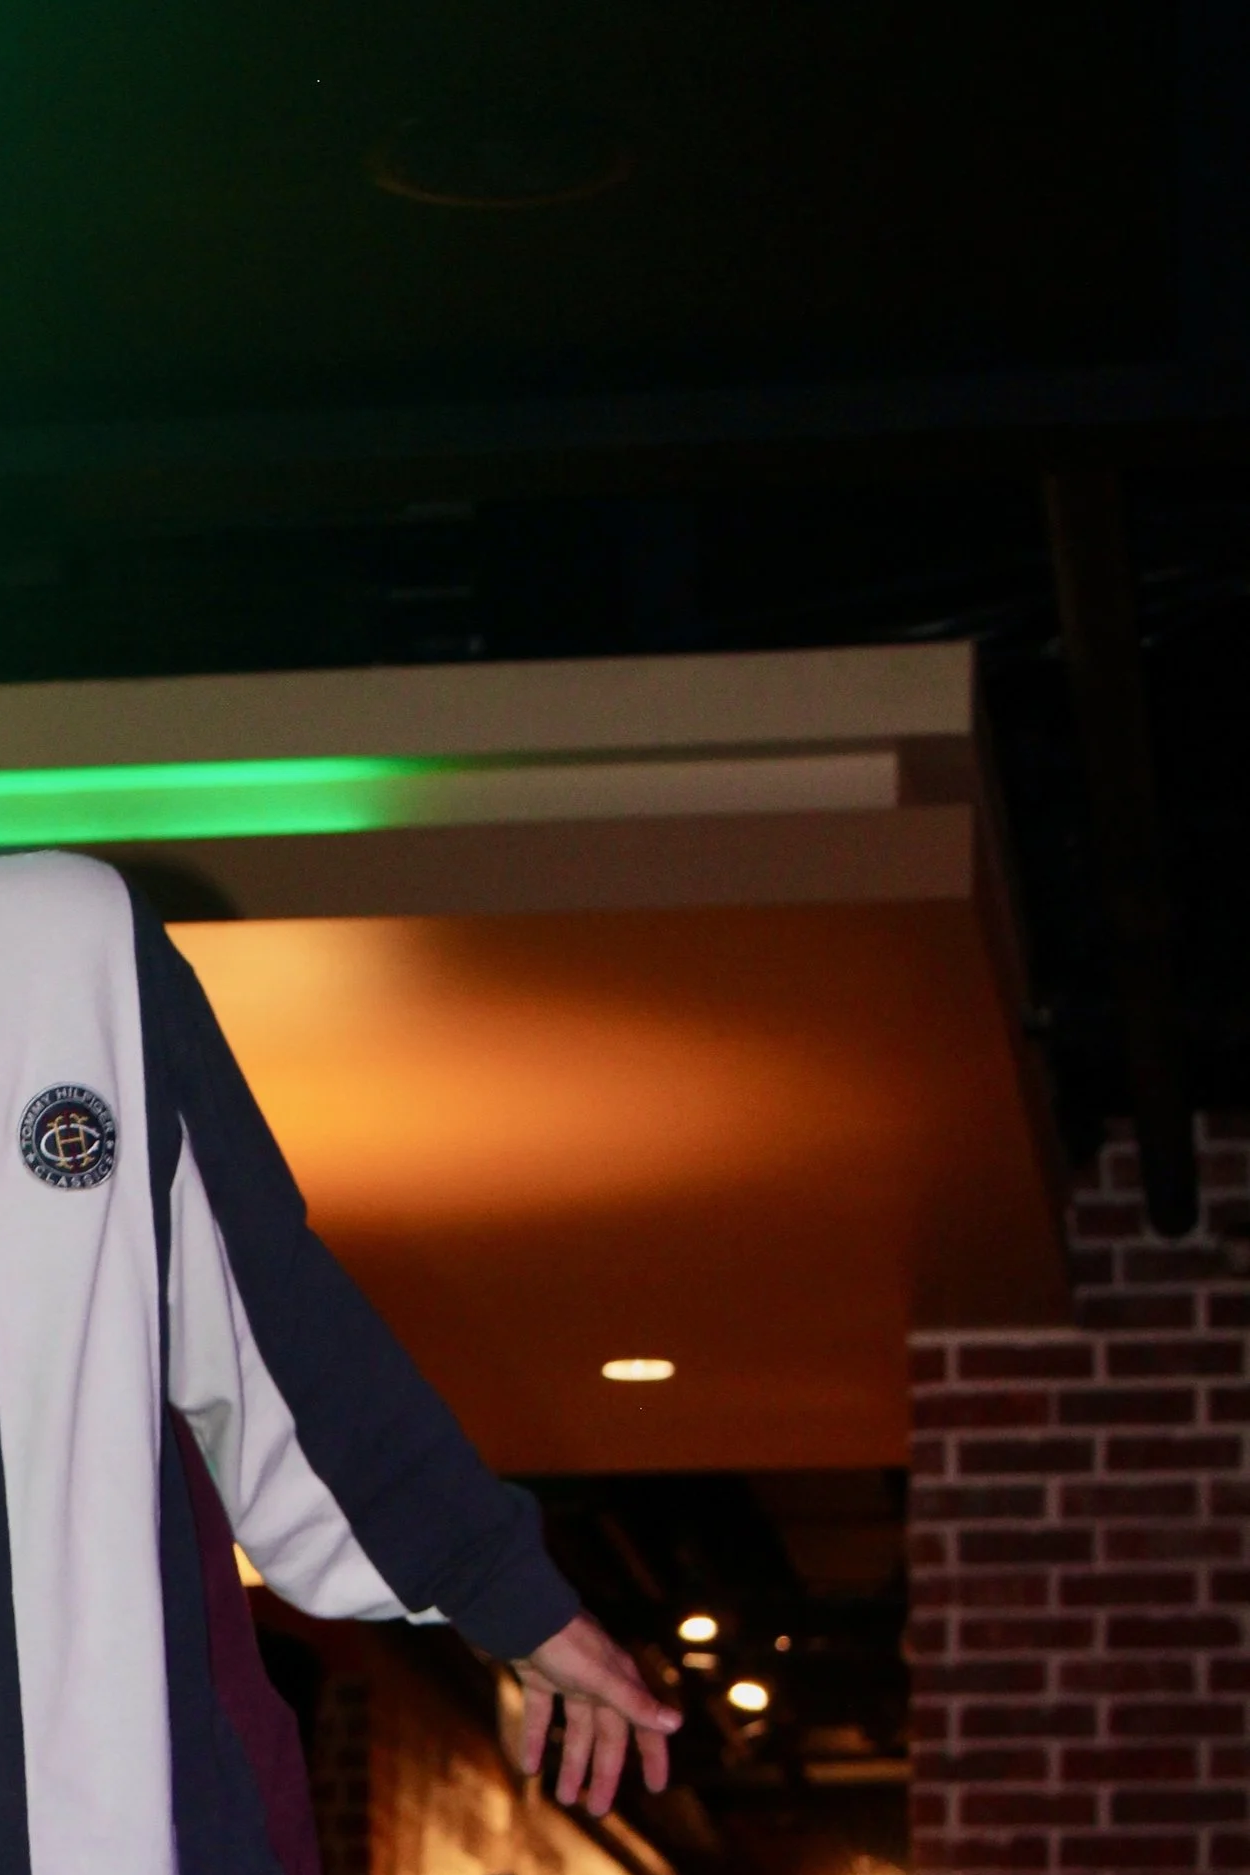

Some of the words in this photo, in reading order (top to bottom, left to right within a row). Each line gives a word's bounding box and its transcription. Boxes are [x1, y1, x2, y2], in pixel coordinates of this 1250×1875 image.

[21, 1093, 51, 1149] TOMMY
[55, 1086, 114, 1133] HILFIGER
[35, 1153, 114, 1188] CLASSICS
